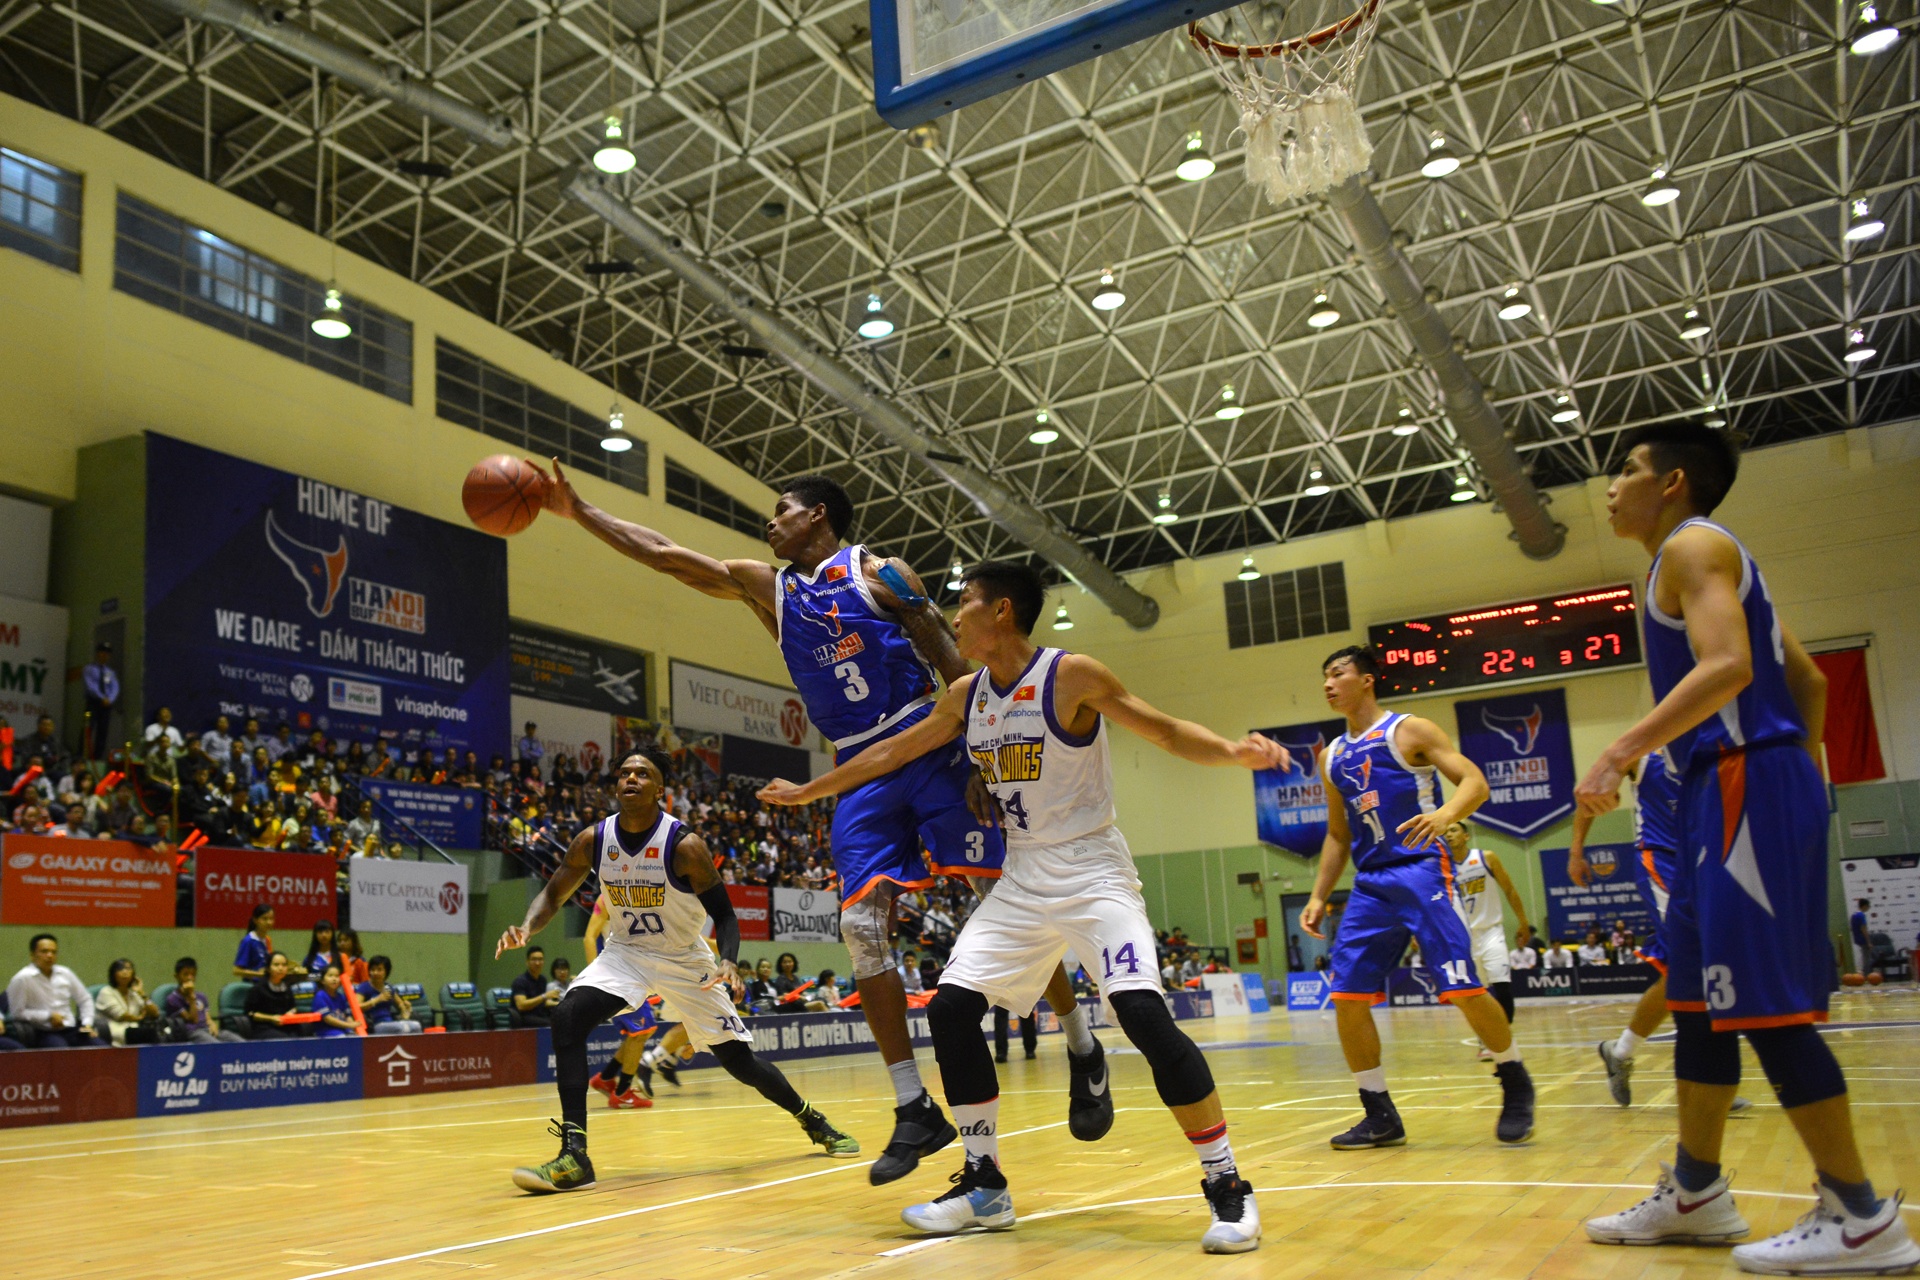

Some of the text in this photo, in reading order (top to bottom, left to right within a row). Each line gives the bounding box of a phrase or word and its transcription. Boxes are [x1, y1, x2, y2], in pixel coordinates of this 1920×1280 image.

[298, 477, 392, 536] HOME OF
[350, 578, 424, 616] HANOI
[815, 582, 856, 597] vinaphone
[350, 604, 424, 632] BUFFALOES
[215, 608, 246, 642] WE
[251, 616, 301, 652] DARE
[320, 628, 358, 663] DÁM
[363, 639, 418, 674] THÁCH
[421, 651, 465, 684] THỨC
[815, 632, 862, 660] HANOI
[1386, 633, 1620, 675] 04 06 22 4 3 27
[0, 658, 48, 695] MỸ
[218, 663, 288, 686] VIET CAPITAL
[834, 661, 870, 702] 3
[261, 685, 289, 698] BANK
[688, 679, 778, 719] VIET CAPITAL
[395, 696, 468, 722] vinaphone
[1003, 708, 1042, 720] vinaphone
[743, 716, 778, 738] BANK
[1004, 732, 1022, 743] MINH
[998, 741, 1044, 783] WINGS
[1488, 758, 1547, 777] HANOI
[1277, 784, 1323, 801] HANO
[1490, 784, 1552, 804] WE DARE
[1279, 807, 1328, 826] WE DAR
[965, 831, 984, 863] 3
[1590, 850, 1615, 864] VBA
[39, 853, 171, 875] GALAXY CINEMA
[635, 864, 664, 872] vinaphone
[204, 872, 328, 895] CALIFORNIA
[357, 880, 437, 899] VIET CAPITAL
[405, 901, 435, 913] BANK
[605, 885, 666, 908] CITY WINGS
[622, 910, 665, 935] 20
[775, 910, 837, 937] SPALDING
[1101, 942, 1140, 979] 14
[716, 1015, 746, 1033] 20
[782, 1021, 800, 1050] RỔ
[803, 1018, 850, 1048] CHUYÊN
[315, 1058, 331, 1069] PHI
[332, 1056, 349, 1068] CƠ
[422, 1056, 492, 1072] VICTORIA
[0, 1083, 60, 1101] ORIA
[220, 1072, 348, 1093] DUY NHẤT TẠI VIỆT NAM
